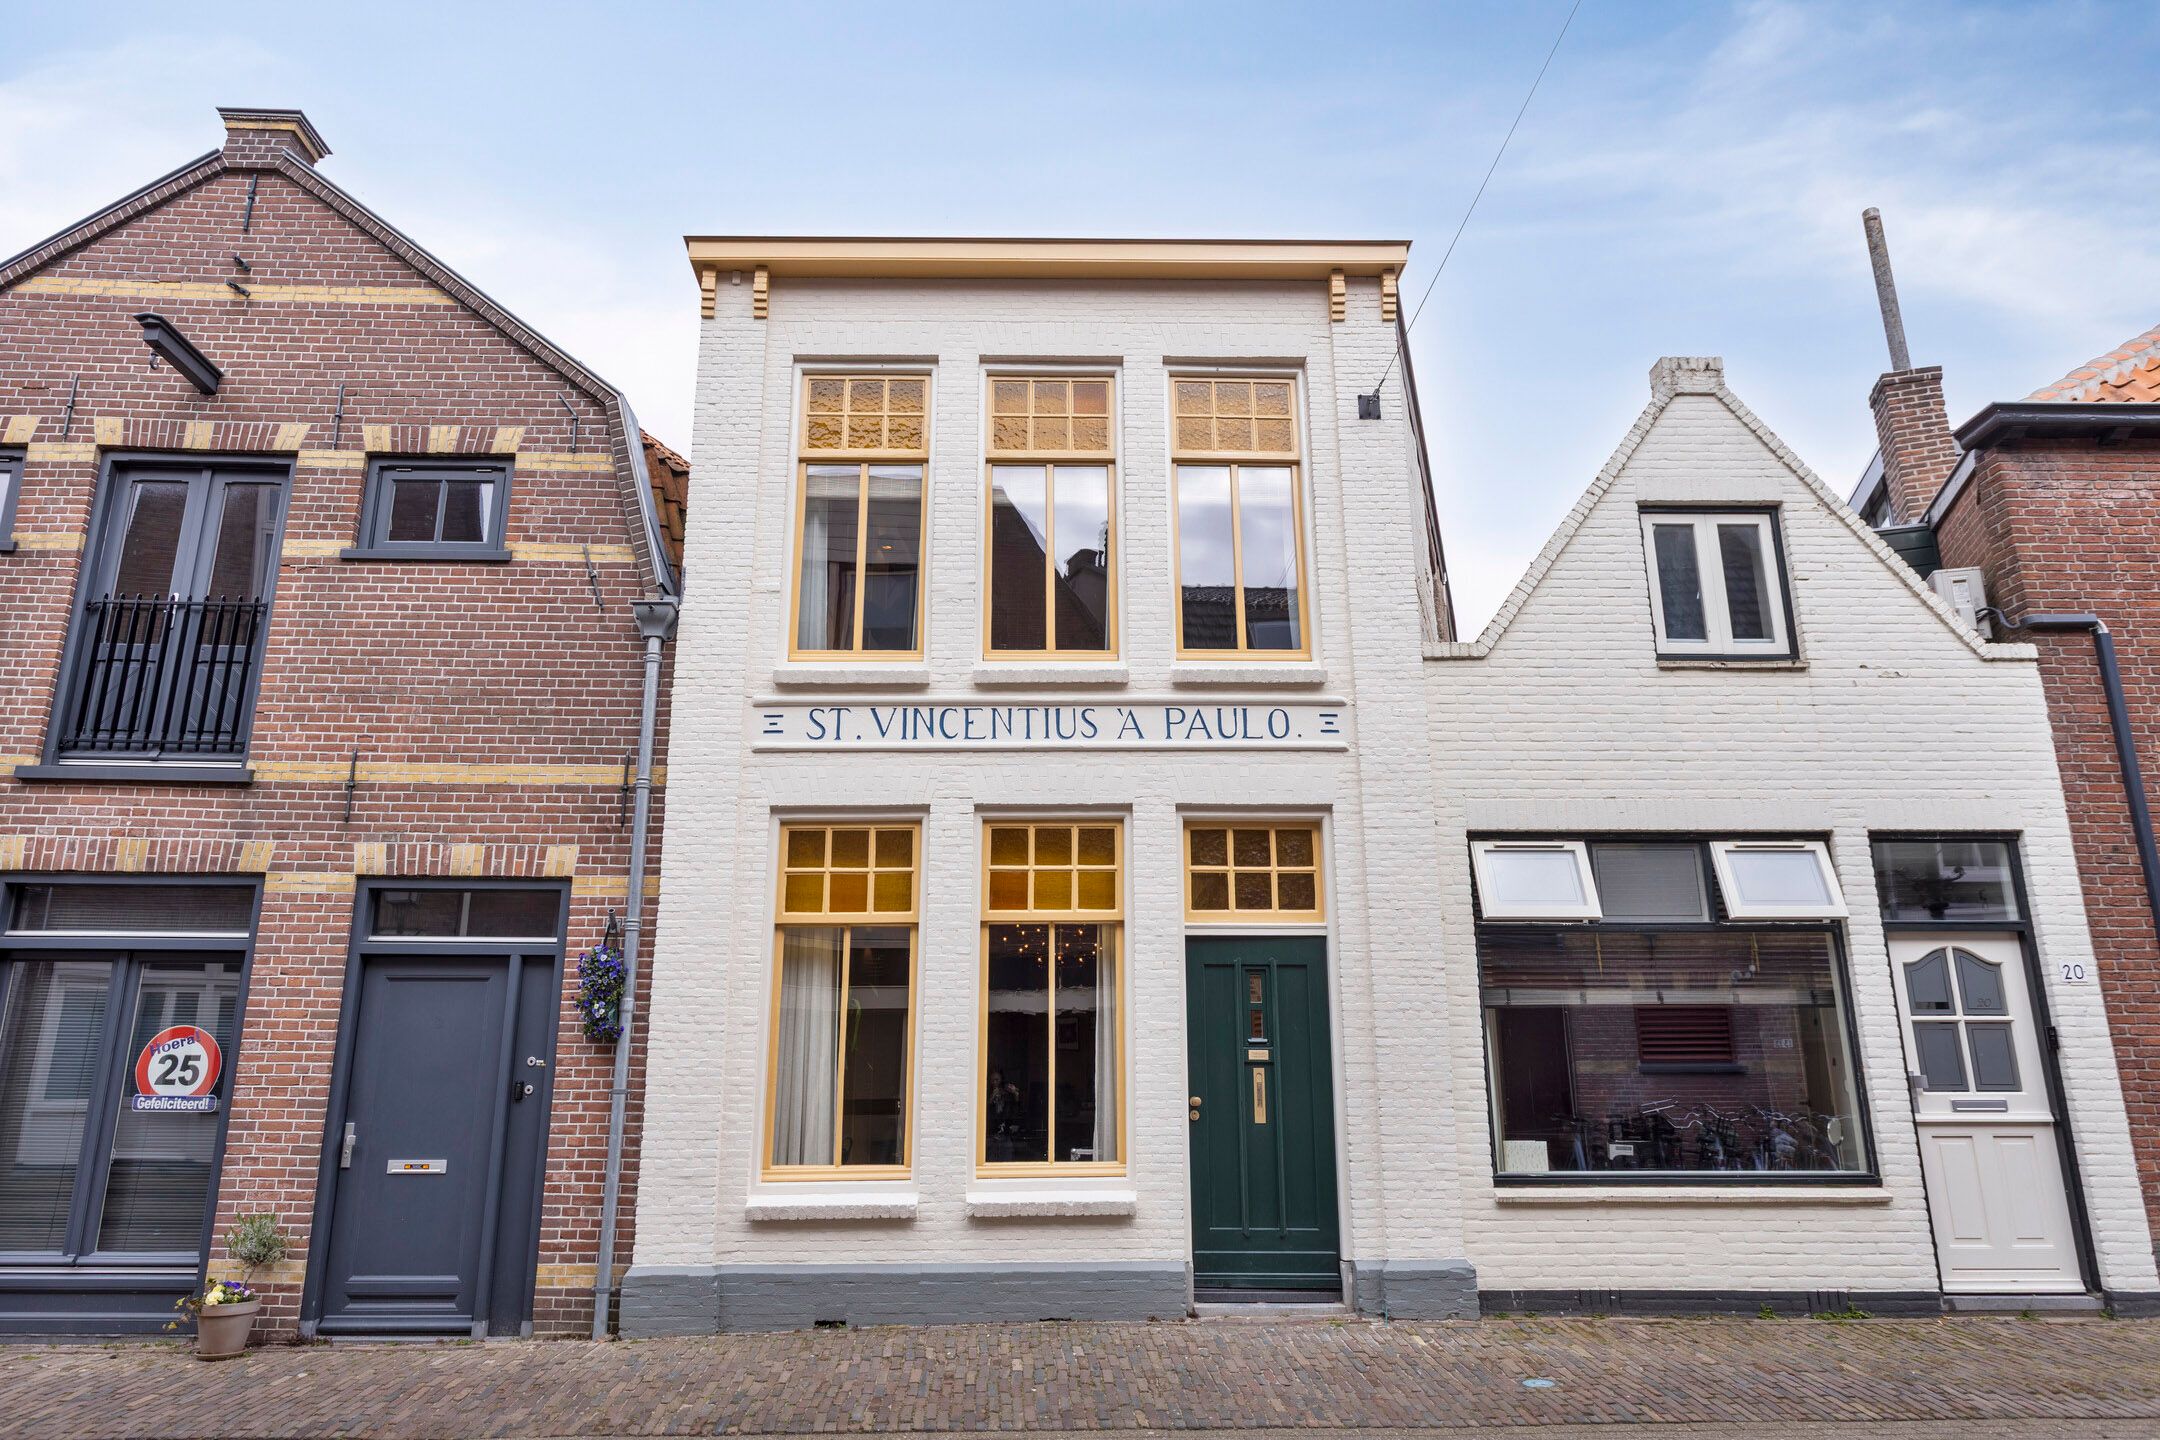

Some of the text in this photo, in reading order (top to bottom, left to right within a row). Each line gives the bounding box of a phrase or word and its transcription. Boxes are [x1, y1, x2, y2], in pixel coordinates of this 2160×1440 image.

[806, 707, 862, 741] ST.
[869, 707, 1098, 740] VINCENTIUS
[1164, 707, 1302, 740] PAULO.
[2062, 964, 2085, 980] 20
[149, 1027, 201, 1057] Hoera!
[154, 1054, 202, 1087] 25
[136, 1096, 210, 1110] Gefeliciteerd!
